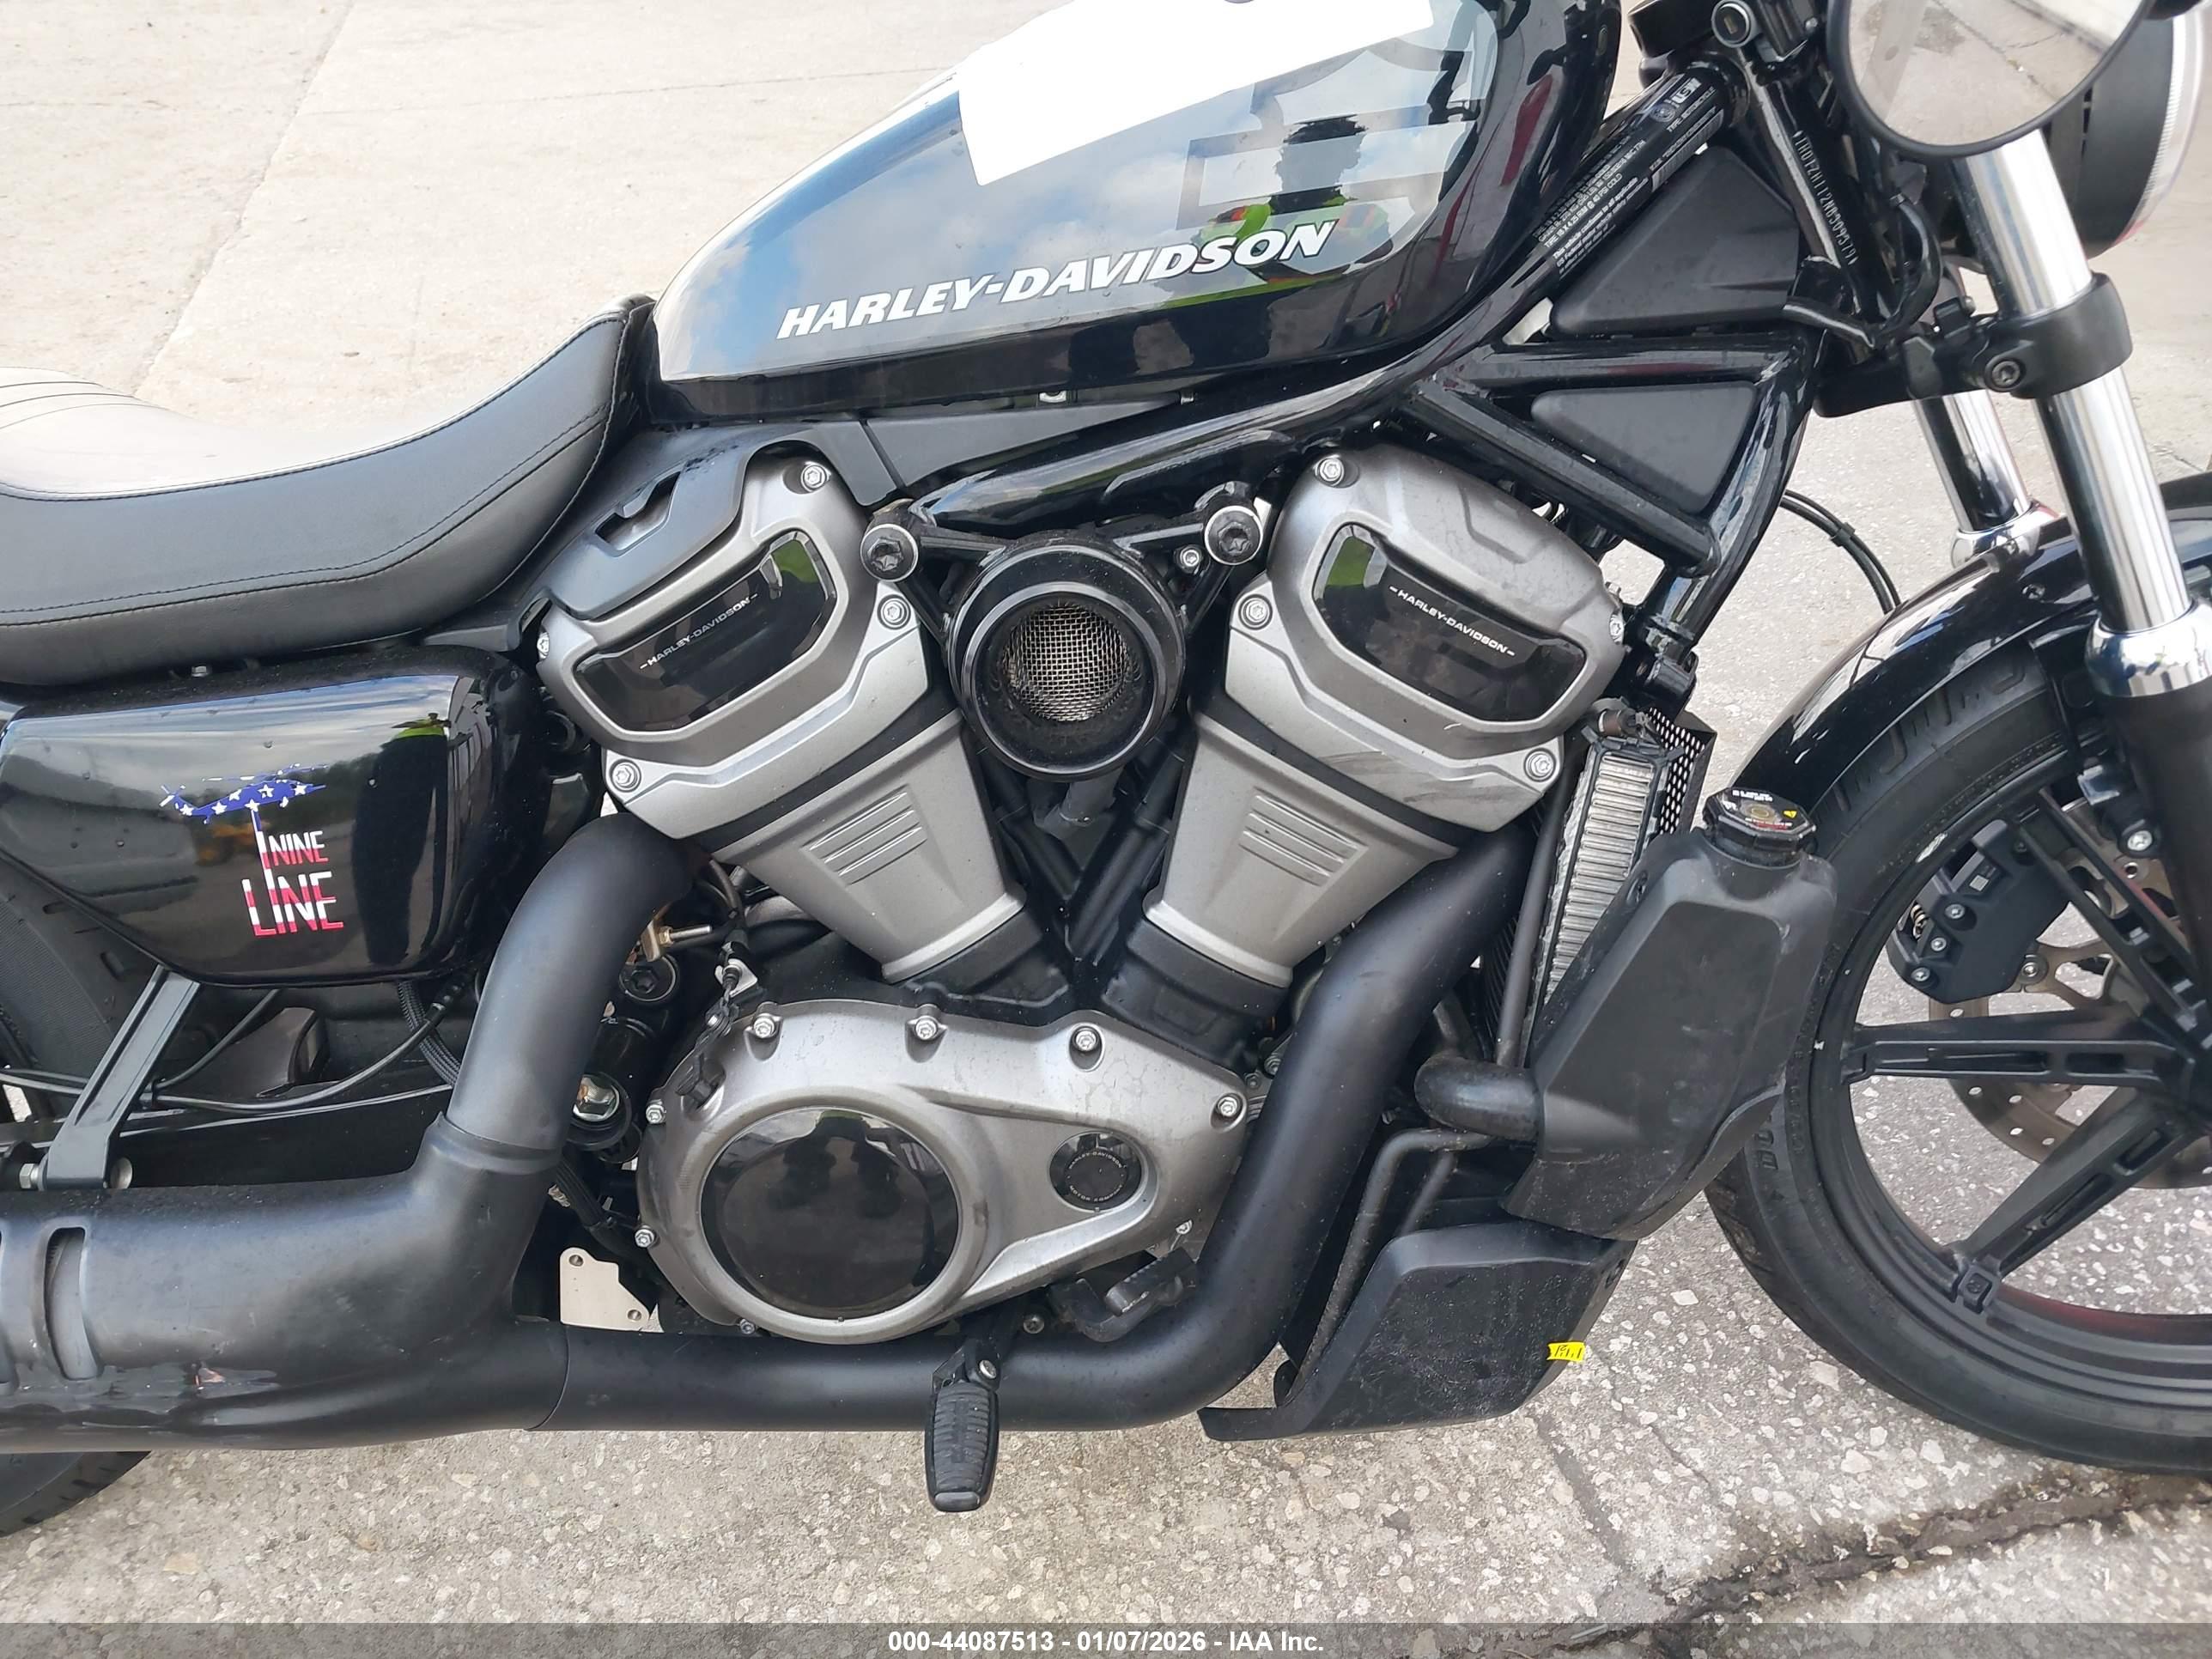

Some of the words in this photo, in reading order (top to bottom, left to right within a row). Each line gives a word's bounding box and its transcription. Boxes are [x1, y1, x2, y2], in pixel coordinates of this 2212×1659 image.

[1544, 234, 1559, 248] TIRE
[1606, 172, 1623, 188] COLD
[1553, 246, 1565, 258] This
[1563, 230, 1582, 249] vehicle
[1563, 241, 1582, 258] Federal
[775, 220, 1338, 339] HARLEY-DAVIDSON
[268, 830, 329, 866] NINE
[241, 871, 344, 937] LINE
